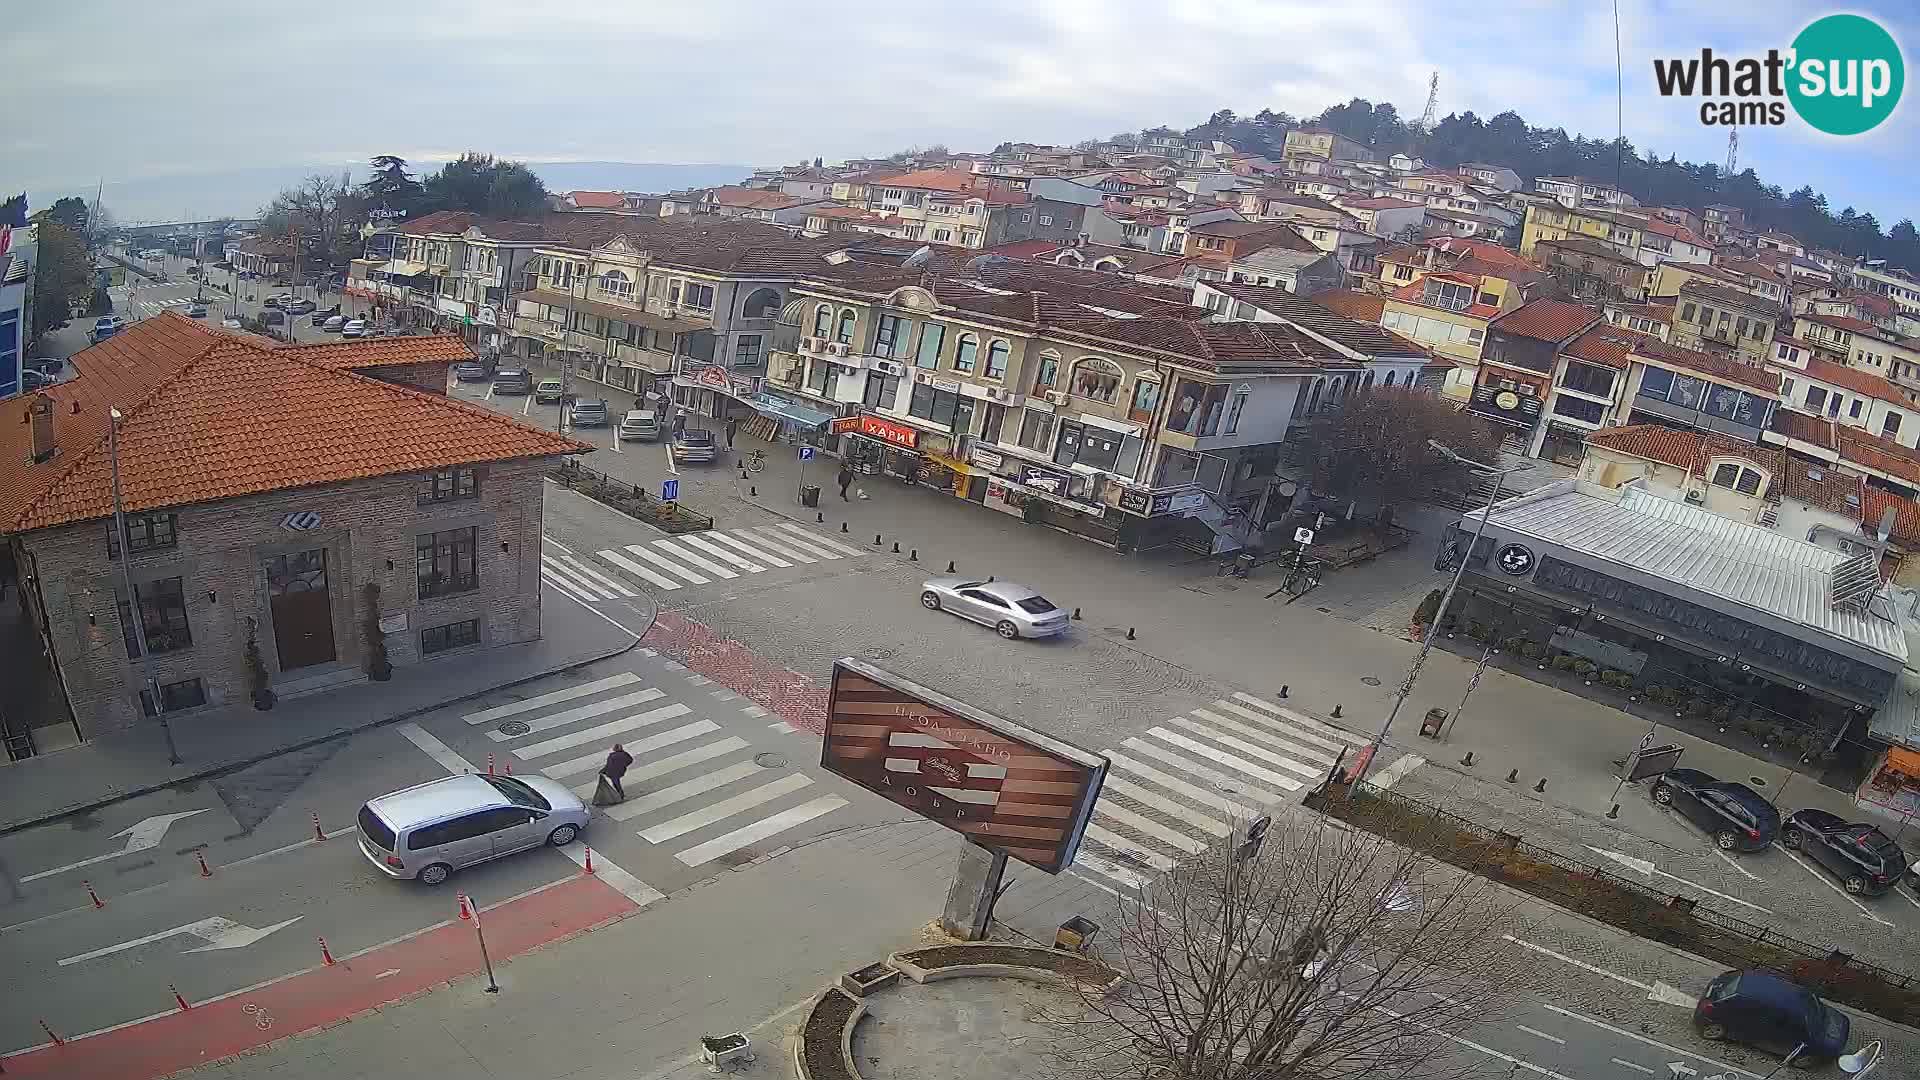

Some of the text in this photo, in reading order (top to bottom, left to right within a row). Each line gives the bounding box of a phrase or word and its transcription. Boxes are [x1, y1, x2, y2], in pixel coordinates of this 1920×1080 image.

[868, 423, 905, 442] ХАРИ
[802, 448, 811, 459] P
[881, 774, 992, 831] ДОБРА
